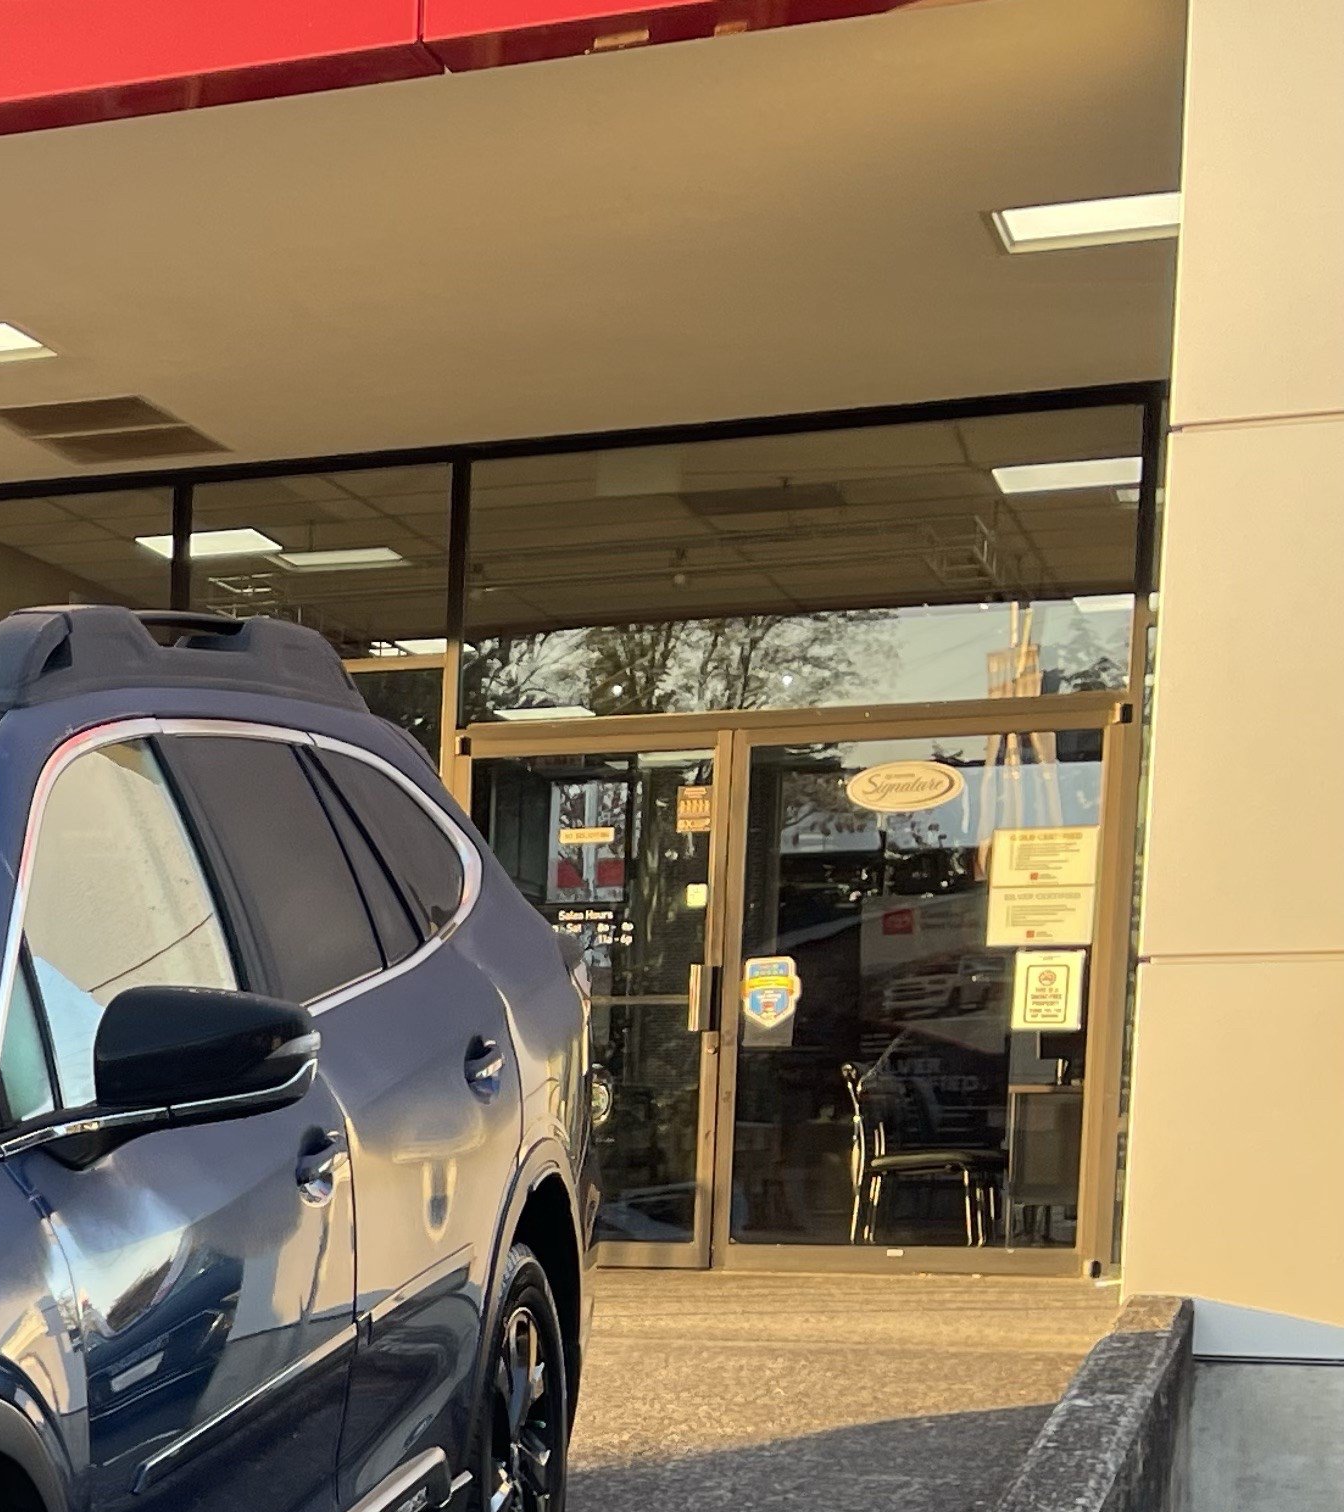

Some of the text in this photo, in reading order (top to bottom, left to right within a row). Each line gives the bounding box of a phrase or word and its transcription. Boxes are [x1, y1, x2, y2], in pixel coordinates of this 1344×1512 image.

[862, 773, 944, 802] Signature
[558, 909, 614, 921] Sales Hours
